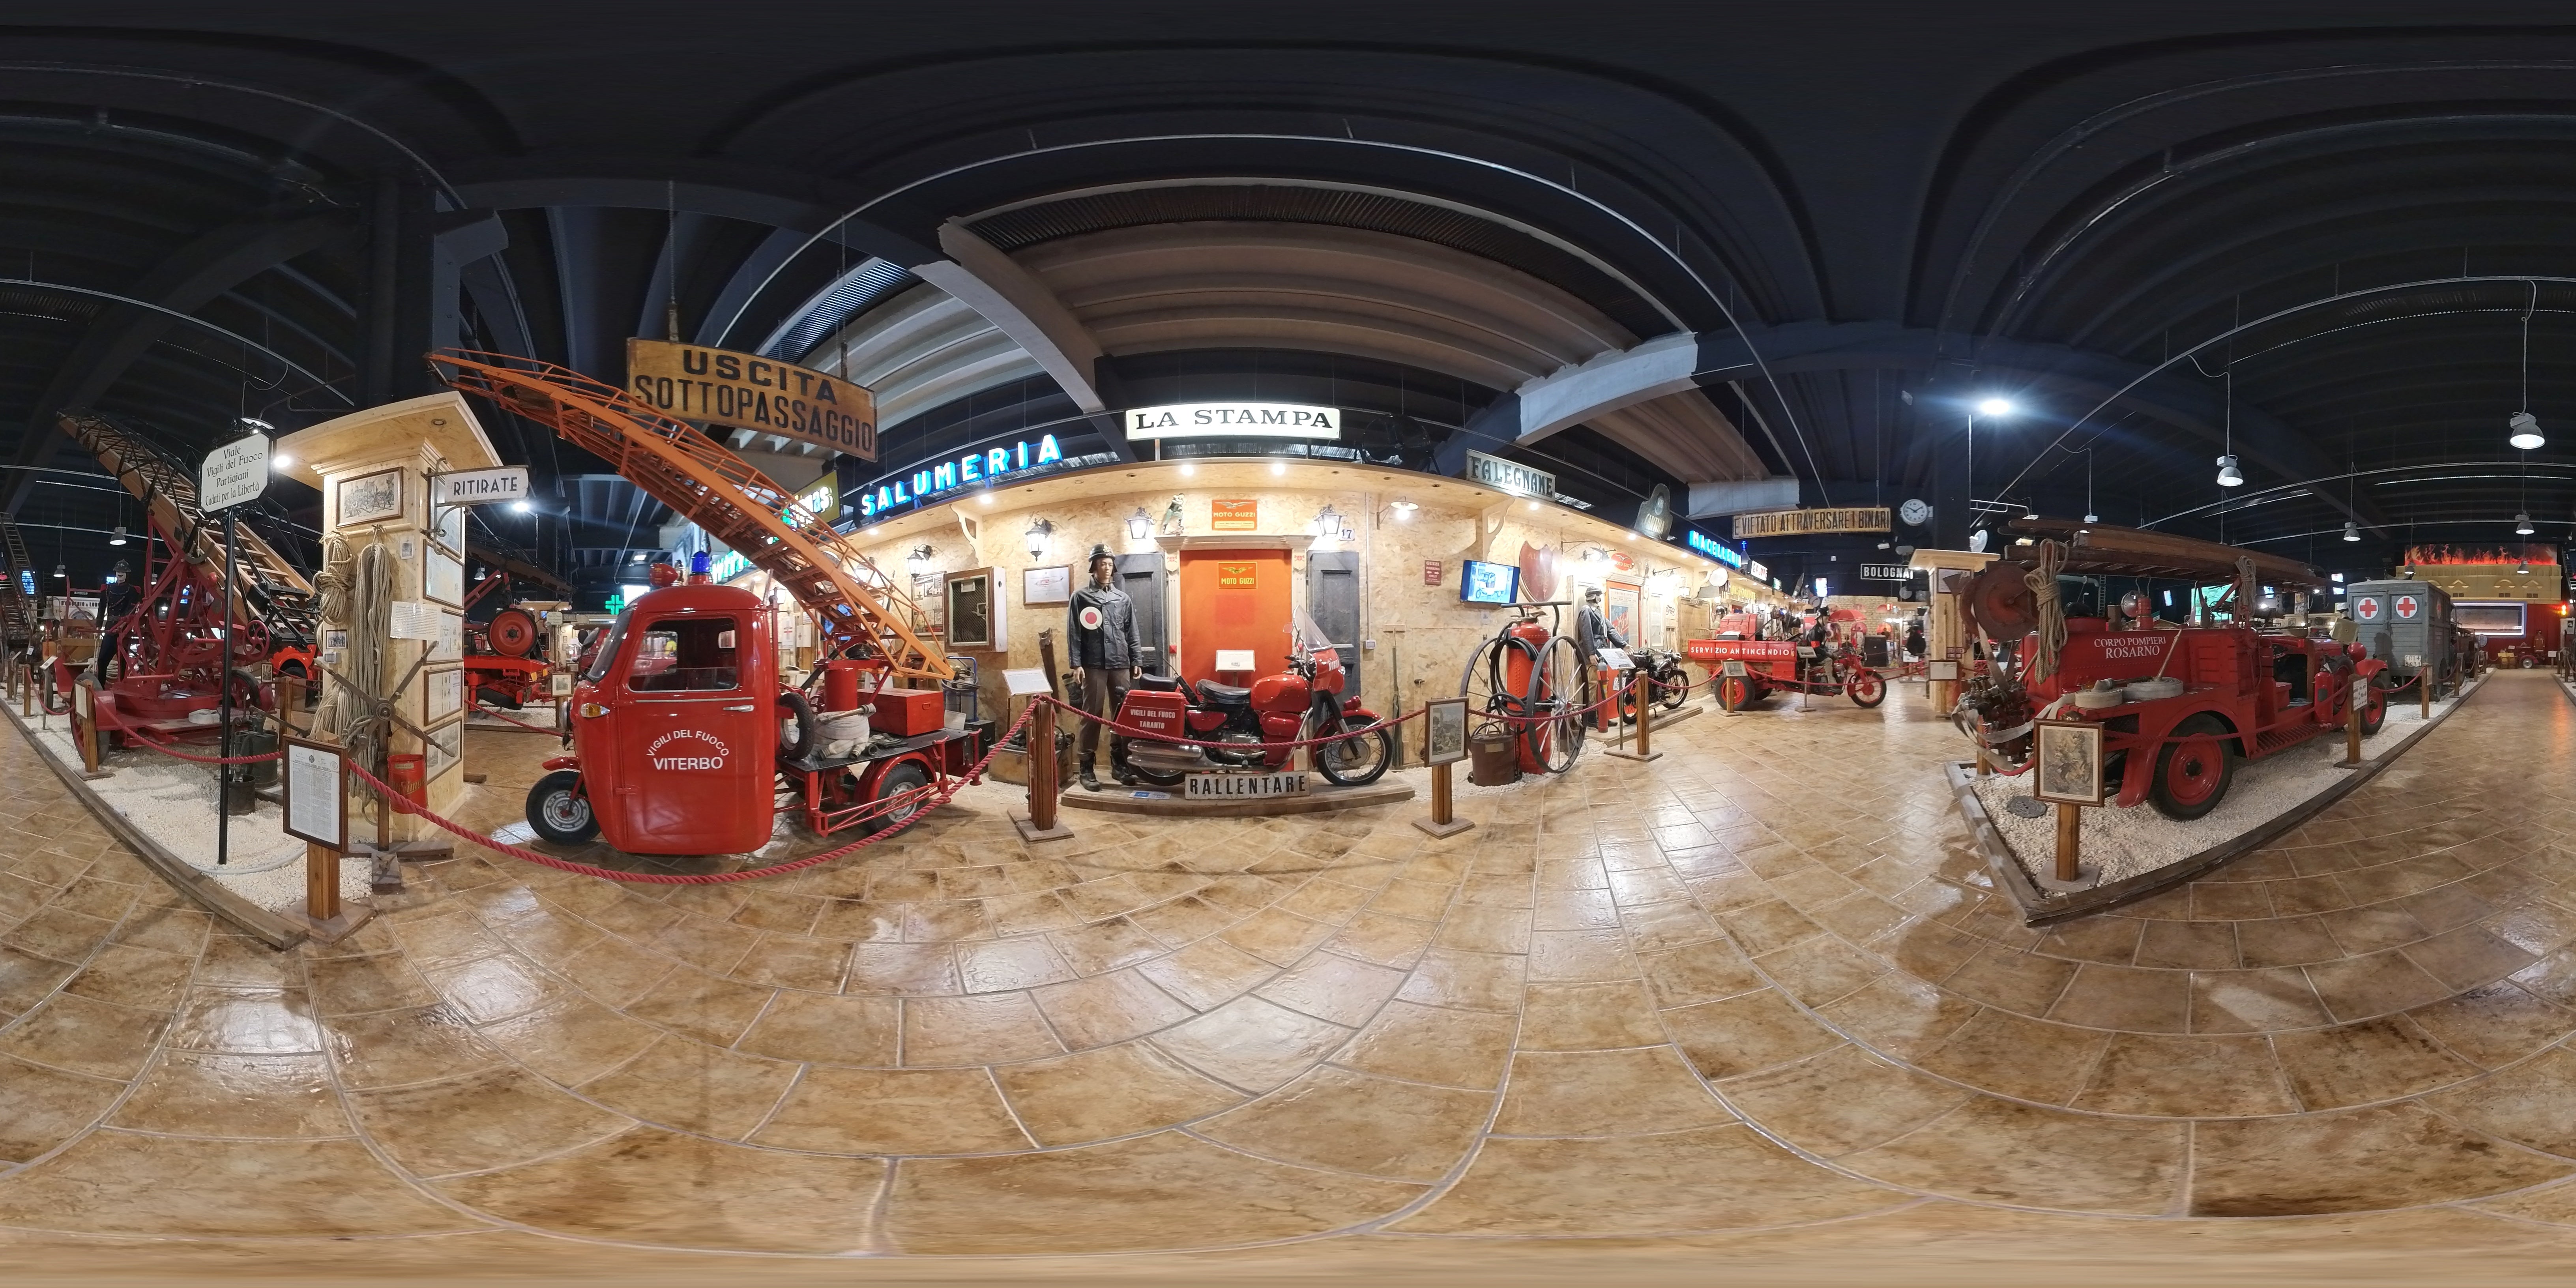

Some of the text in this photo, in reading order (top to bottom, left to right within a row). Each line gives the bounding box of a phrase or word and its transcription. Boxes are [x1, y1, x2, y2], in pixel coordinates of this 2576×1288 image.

[683, 350, 838, 405] USCITA
[635, 375, 872, 452] SOTTOPASSAGGIO
[1136, 410, 1333, 430] LA STAMPA
[224, 446, 241, 459] Viale
[207, 453, 263, 477] Vigili del Fuoco
[861, 434, 1063, 516] SALUMERIA
[216, 469, 249, 487] Partigiani
[454, 477, 517, 496] RITIRATE
[1471, 456, 1553, 498] FALEGNAME
[205, 493, 220, 506] Caduti
[231, 488, 236, 498] la
[238, 481, 259, 496] Libertà
[1742, 515, 1776, 535] VIETATO
[1780, 511, 1849, 532] ATTRAVERSARE
[1858, 511, 1889, 528] BINARI
[1342, 529, 1352, 539] 17
[1689, 530, 1742, 568] MACELLERIA
[2094, 637, 2166, 648] CORPO POMPIERI
[2105, 645, 2160, 659] ROSARNO
[1140, 721, 1165, 729] TARANTO
[646, 730, 729, 756] VIGILI DEL FUOCO
[653, 757, 723, 770] VITERBO
[1190, 775, 1305, 794] RALLENTARE
